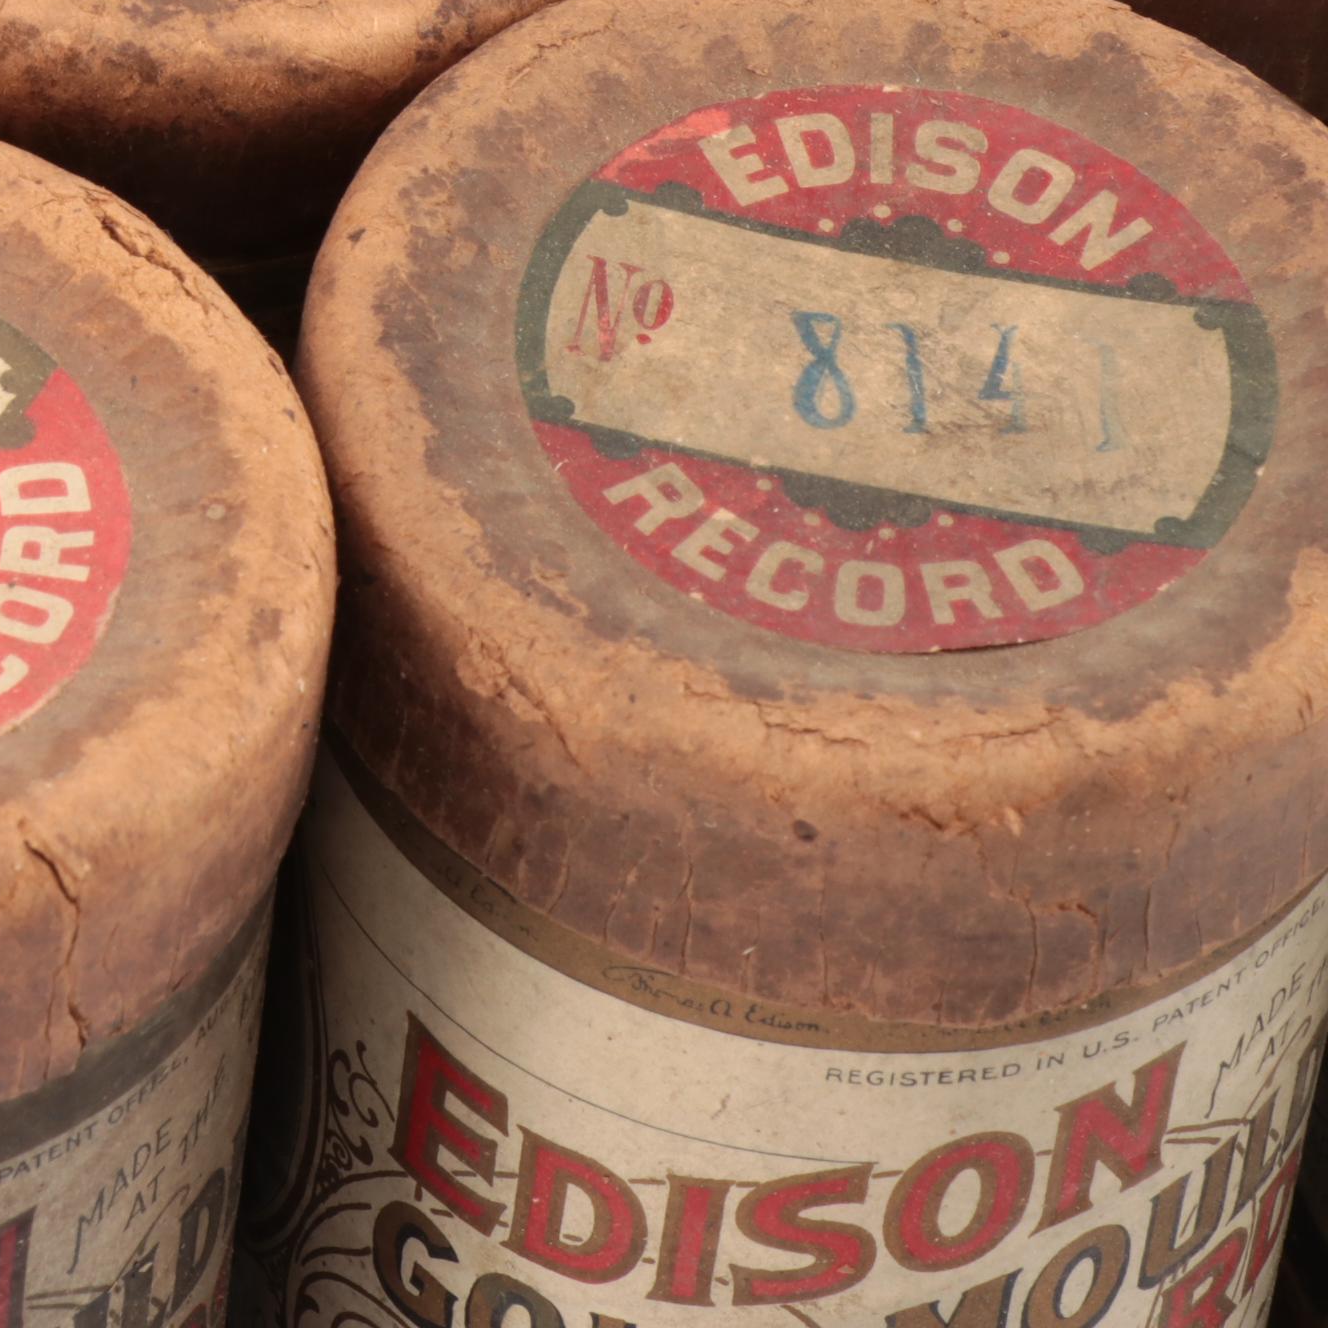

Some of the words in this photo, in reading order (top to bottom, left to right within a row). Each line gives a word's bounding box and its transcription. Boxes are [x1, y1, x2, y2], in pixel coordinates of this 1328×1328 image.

[699, 110, 1152, 272] EDISON
[602, 461, 1086, 628] RECORD
[824, 1062, 1021, 1088] REGISTERED
[1035, 1052, 1065, 1073] IN
[1082, 1029, 1141, 1059] U.S.
[1151, 972, 1248, 1033] PATENT
[1204, 962, 1307, 1119] MADE
[67, 1117, 173, 1275] MADE
[388, 1010, 1187, 1309] EDISON
